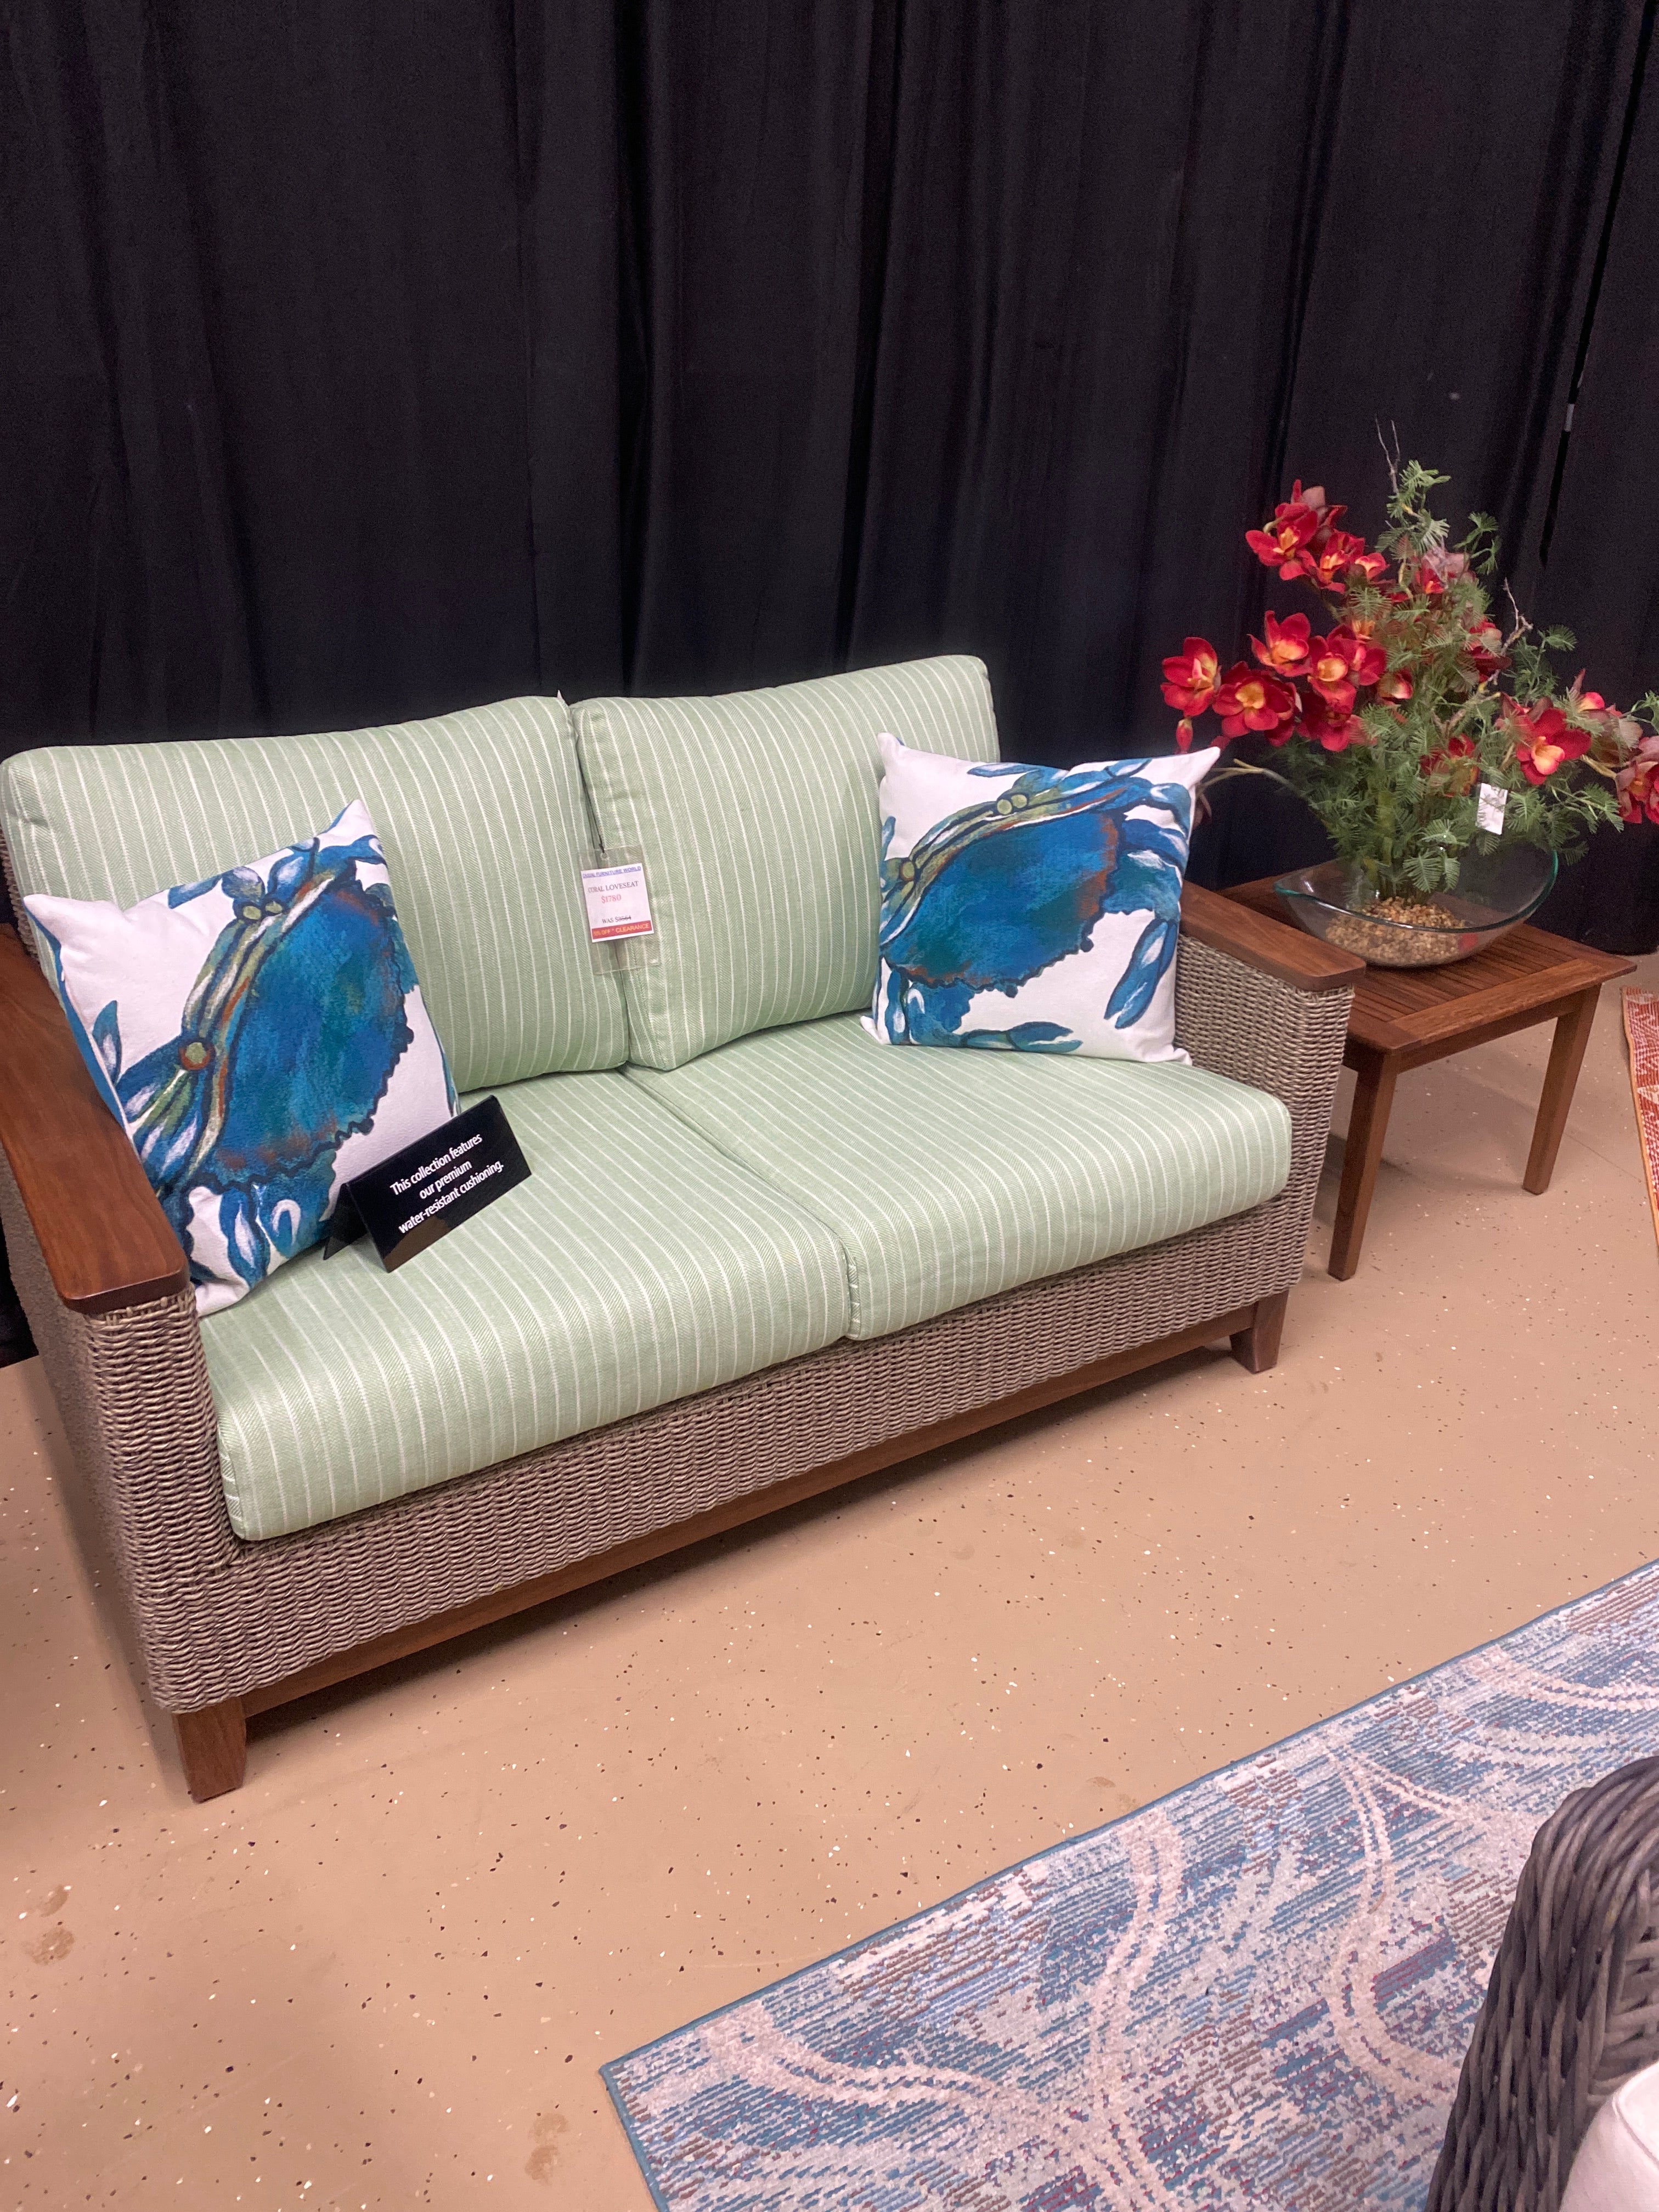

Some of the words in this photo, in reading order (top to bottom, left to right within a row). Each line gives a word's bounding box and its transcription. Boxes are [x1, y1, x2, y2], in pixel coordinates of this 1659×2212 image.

[596, 869, 623, 877] FURNITURE
[606, 881, 639, 891] LOVESEAT
[601, 894, 622, 904] $1780
[616, 923, 650, 933] CLEARANCE
[389, 1175, 411, 1196] This
[410, 1153, 450, 1184] collection
[450, 1133, 483, 1160] features
[419, 1184, 436, 1199] our
[435, 1160, 473, 1193] premium
[398, 1189, 461, 1234] water-resistant
[460, 1160, 505, 1194] cushioning.
